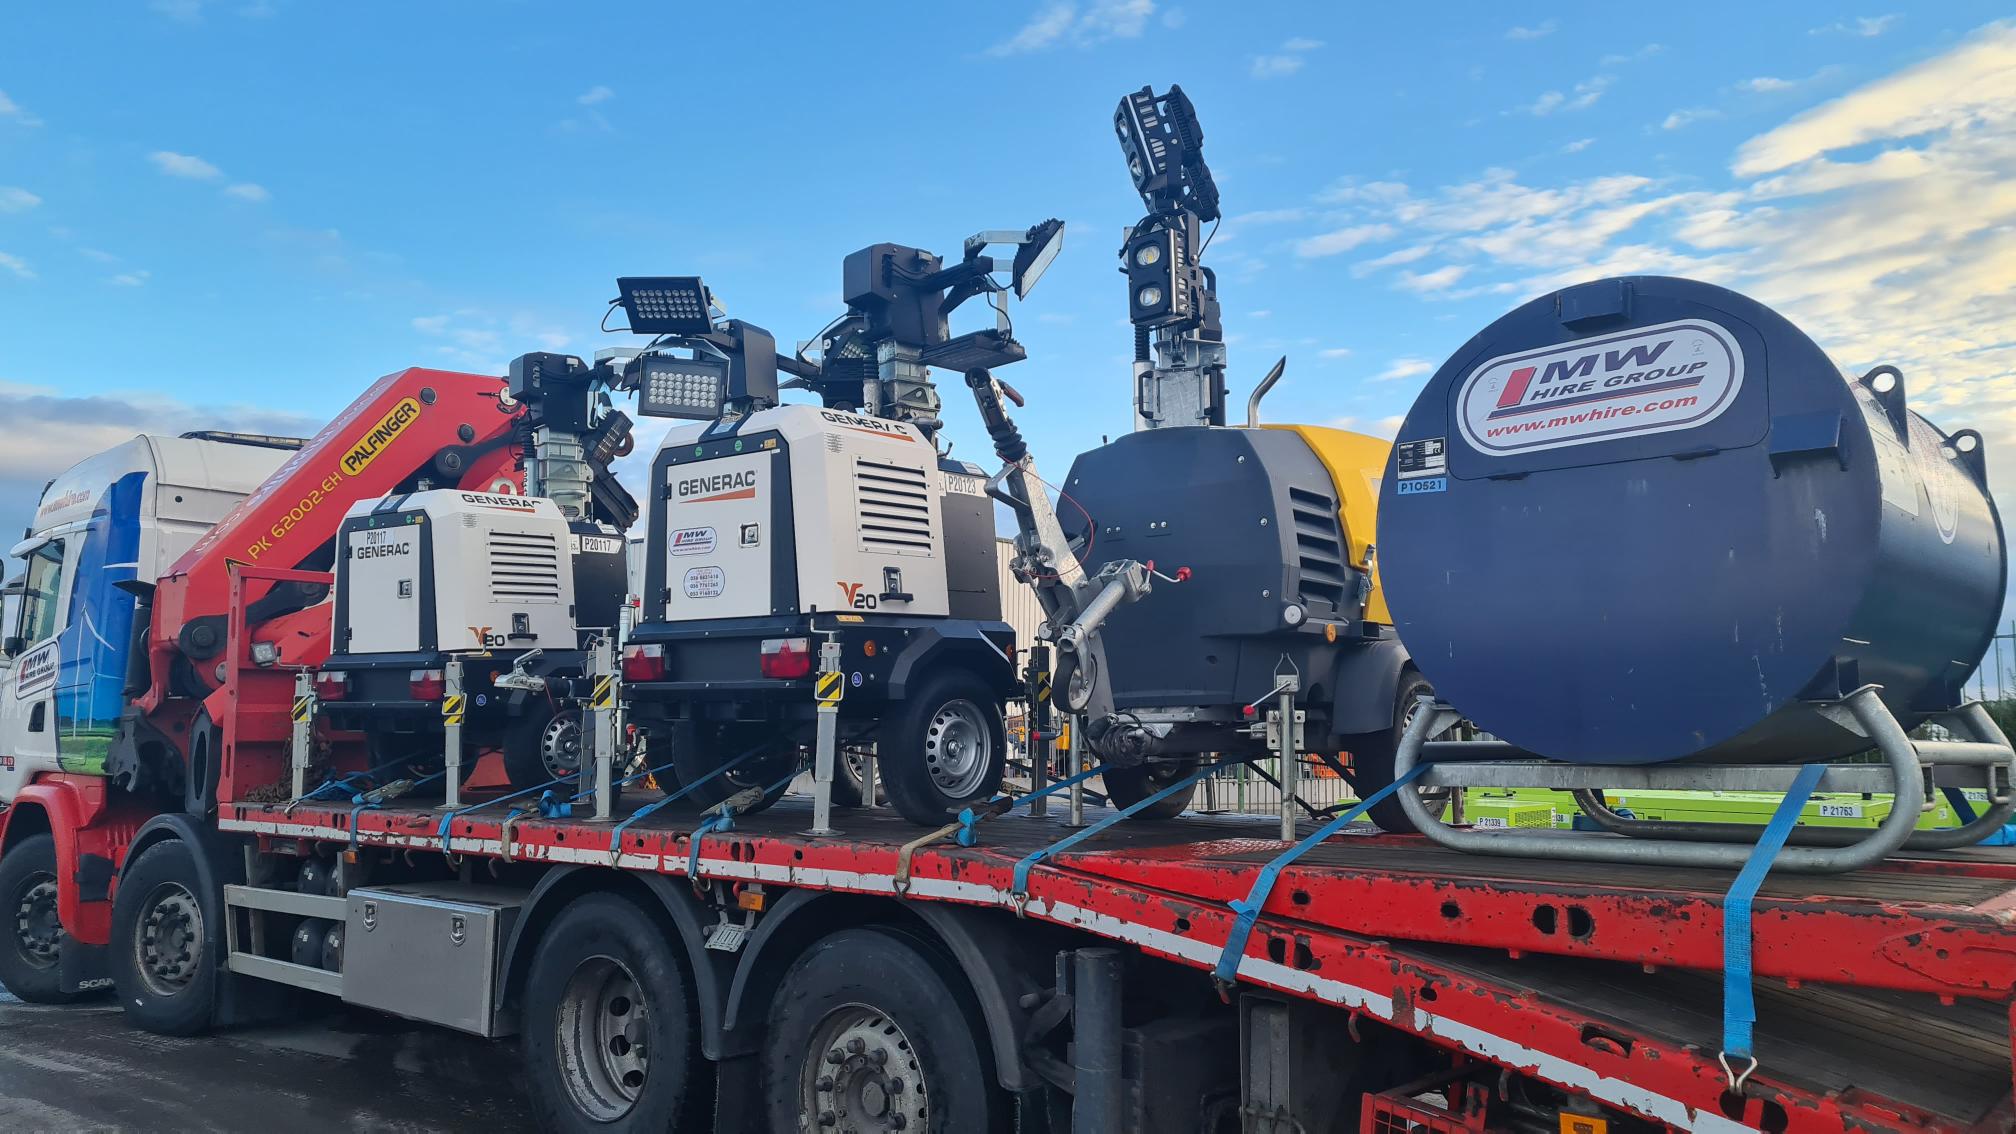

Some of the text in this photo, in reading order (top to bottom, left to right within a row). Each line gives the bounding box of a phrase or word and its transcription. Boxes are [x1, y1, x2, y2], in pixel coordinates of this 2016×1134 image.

[1530, 362, 1708, 401] HIRE GROUP
[1486, 396, 1698, 438] www.mwhire.com
[344, 402, 417, 472] PALFINGER
[678, 470, 756, 496] GENERAC
[948, 476, 976, 494] P20123
[1401, 480, 1442, 492] P10521
[247, 471, 344, 560] PK 62002-EH
[366, 530, 386, 545] P20117
[584, 538, 611, 552] P20117
[358, 542, 410, 560] GENERAC
[1823, 806, 1828, 815] P
